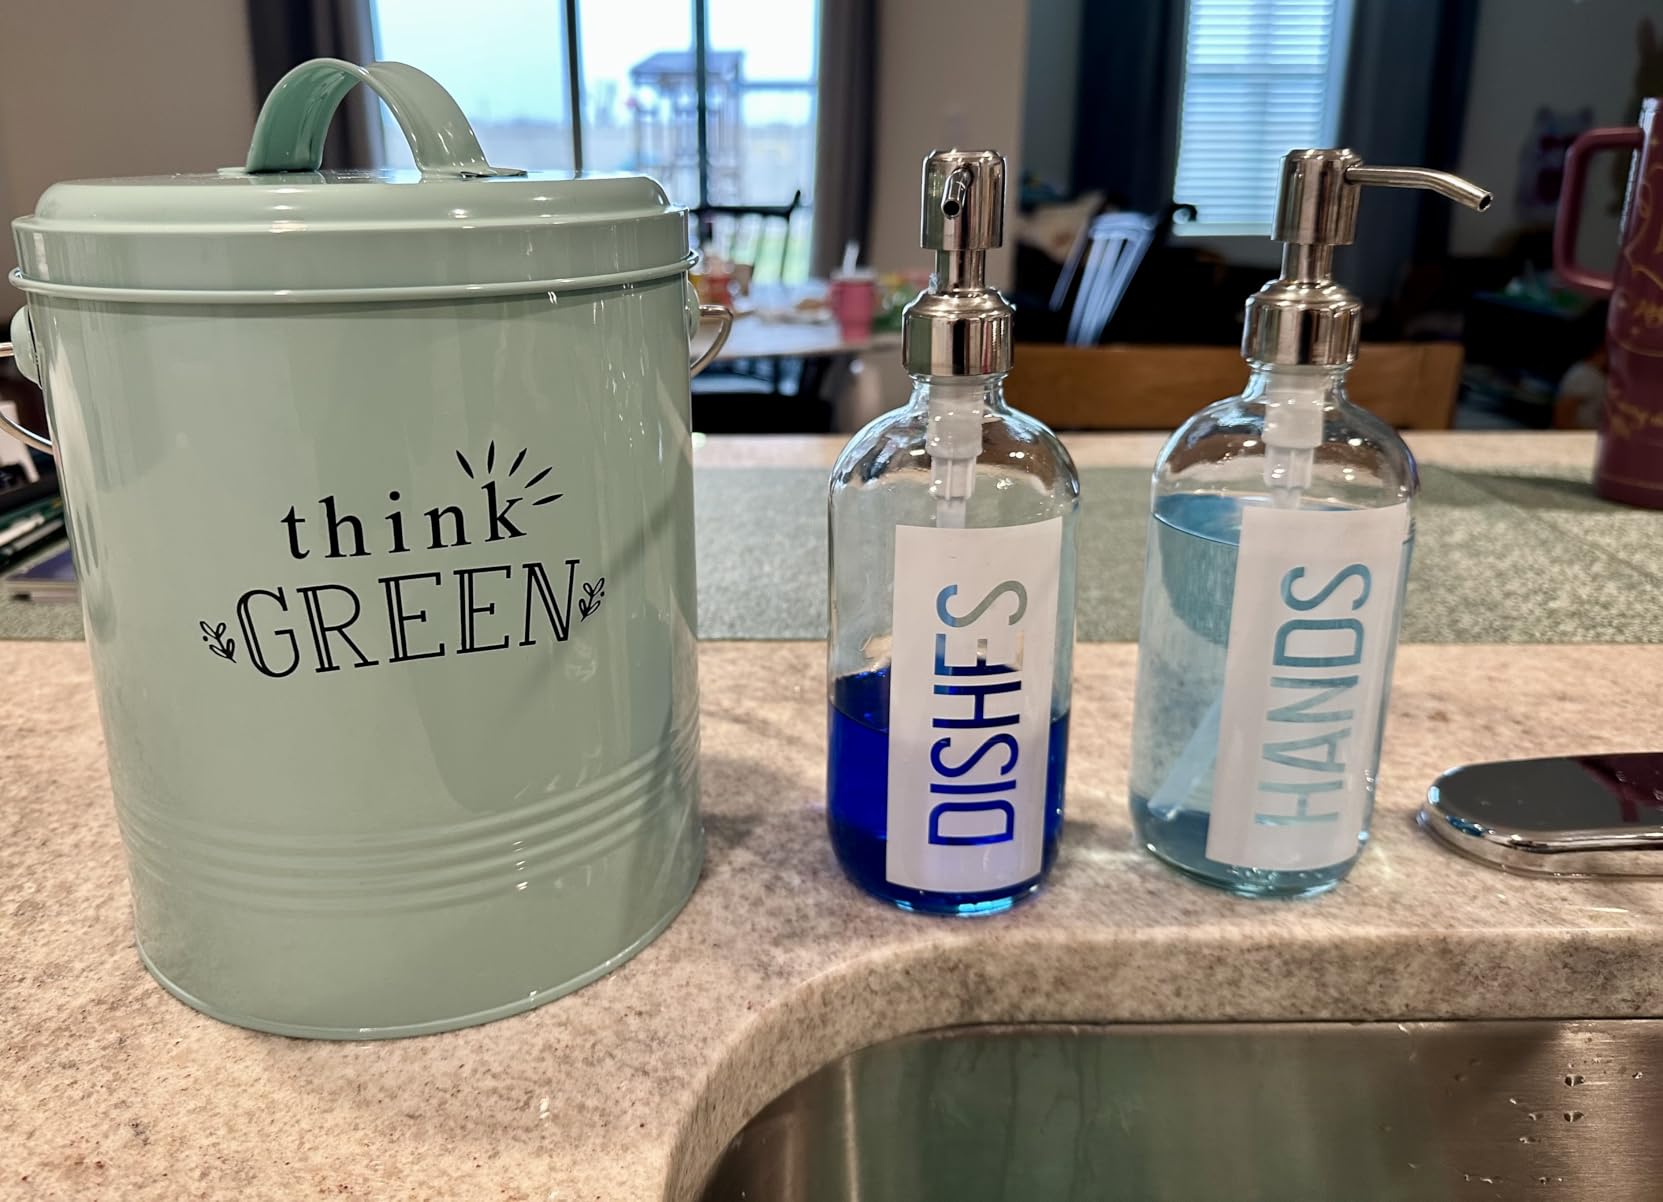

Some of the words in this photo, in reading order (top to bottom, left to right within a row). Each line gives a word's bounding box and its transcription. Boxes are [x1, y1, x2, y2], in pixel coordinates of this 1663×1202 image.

[281, 480, 527, 559] think
[237, 559, 580, 677] GREEN
[1255, 564, 1371, 825] HANDS
[928, 580, 1027, 846] DISHES
